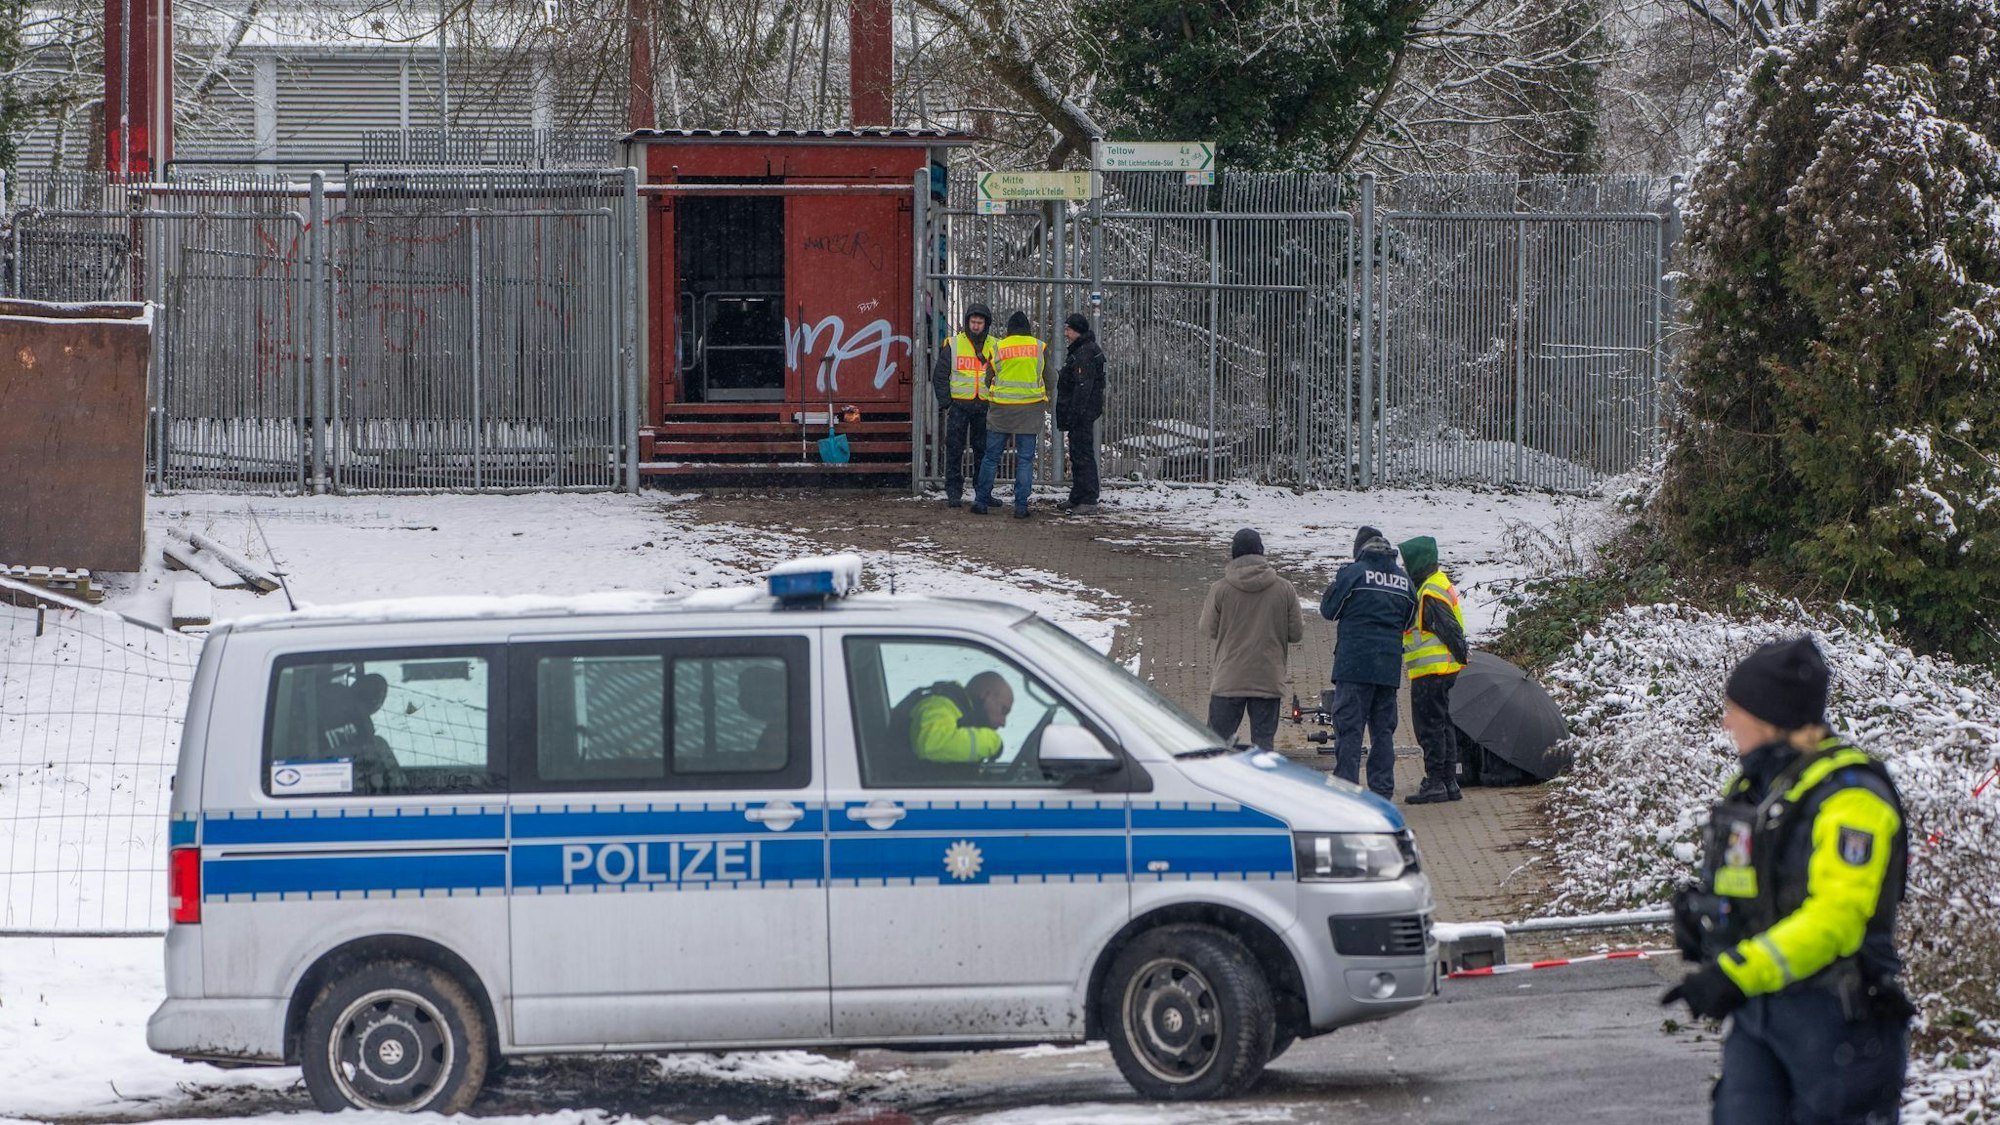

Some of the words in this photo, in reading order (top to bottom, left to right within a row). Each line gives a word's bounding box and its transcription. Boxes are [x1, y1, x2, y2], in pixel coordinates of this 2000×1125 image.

[1106, 146, 1136, 155] Teltow
[1118, 159, 1127, 167] Bhf
[1128, 158, 1174, 167] Lichterfelde-Süd
[1002, 176, 1024, 184] Mitte
[1074, 175, 1081, 184] 13
[999, 346, 1037, 360] POLIZEI
[562, 841, 761, 885] POLIZEI
